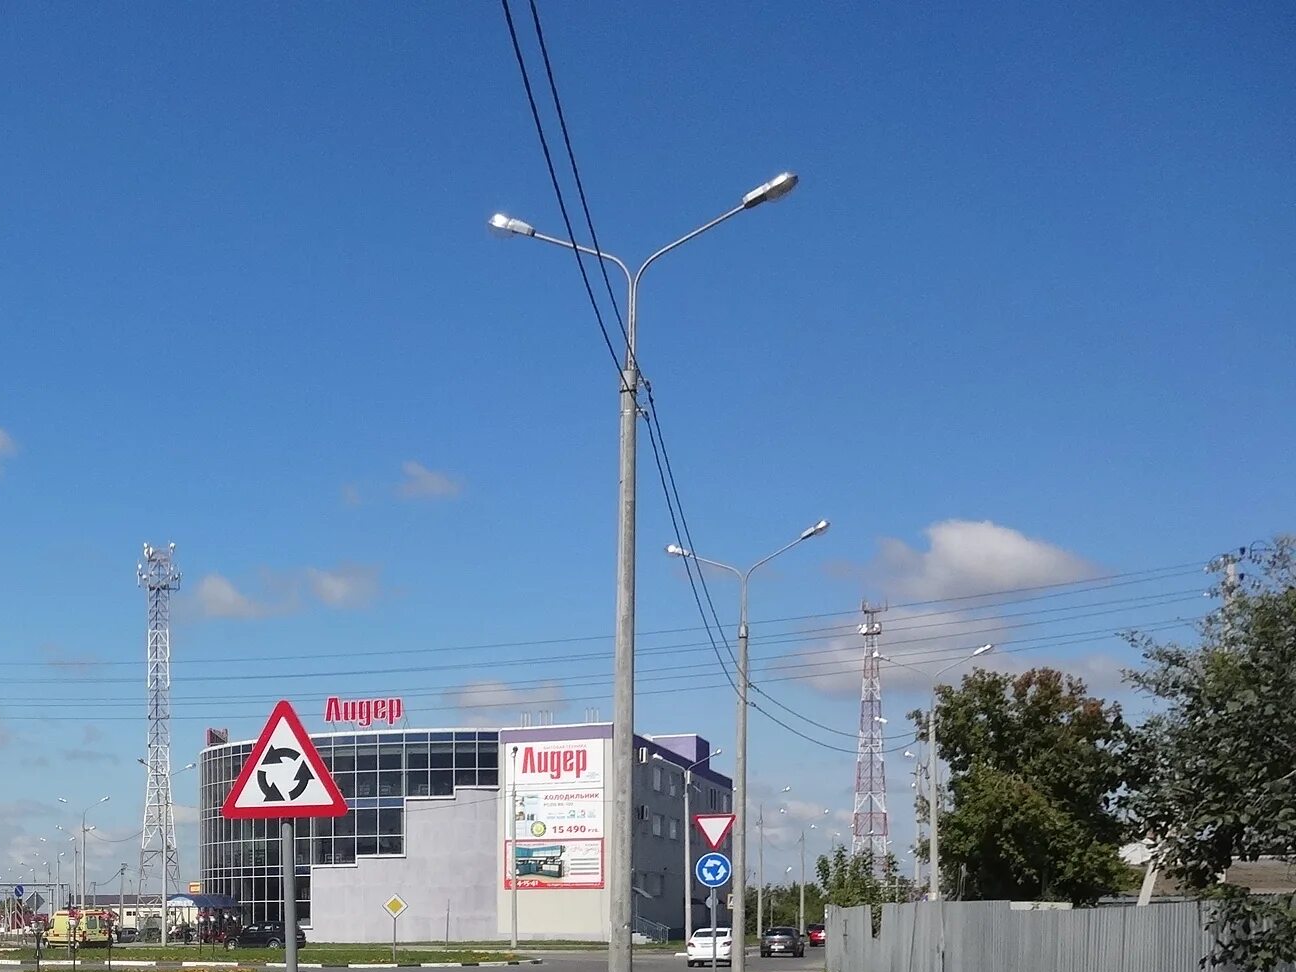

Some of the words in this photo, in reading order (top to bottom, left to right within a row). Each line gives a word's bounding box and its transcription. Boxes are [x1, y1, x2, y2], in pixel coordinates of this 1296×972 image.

[324, 696, 403, 727] Лидер
[521, 746, 588, 780] Лидер
[544, 792, 600, 801] ХОЛОДИЛЬНИК
